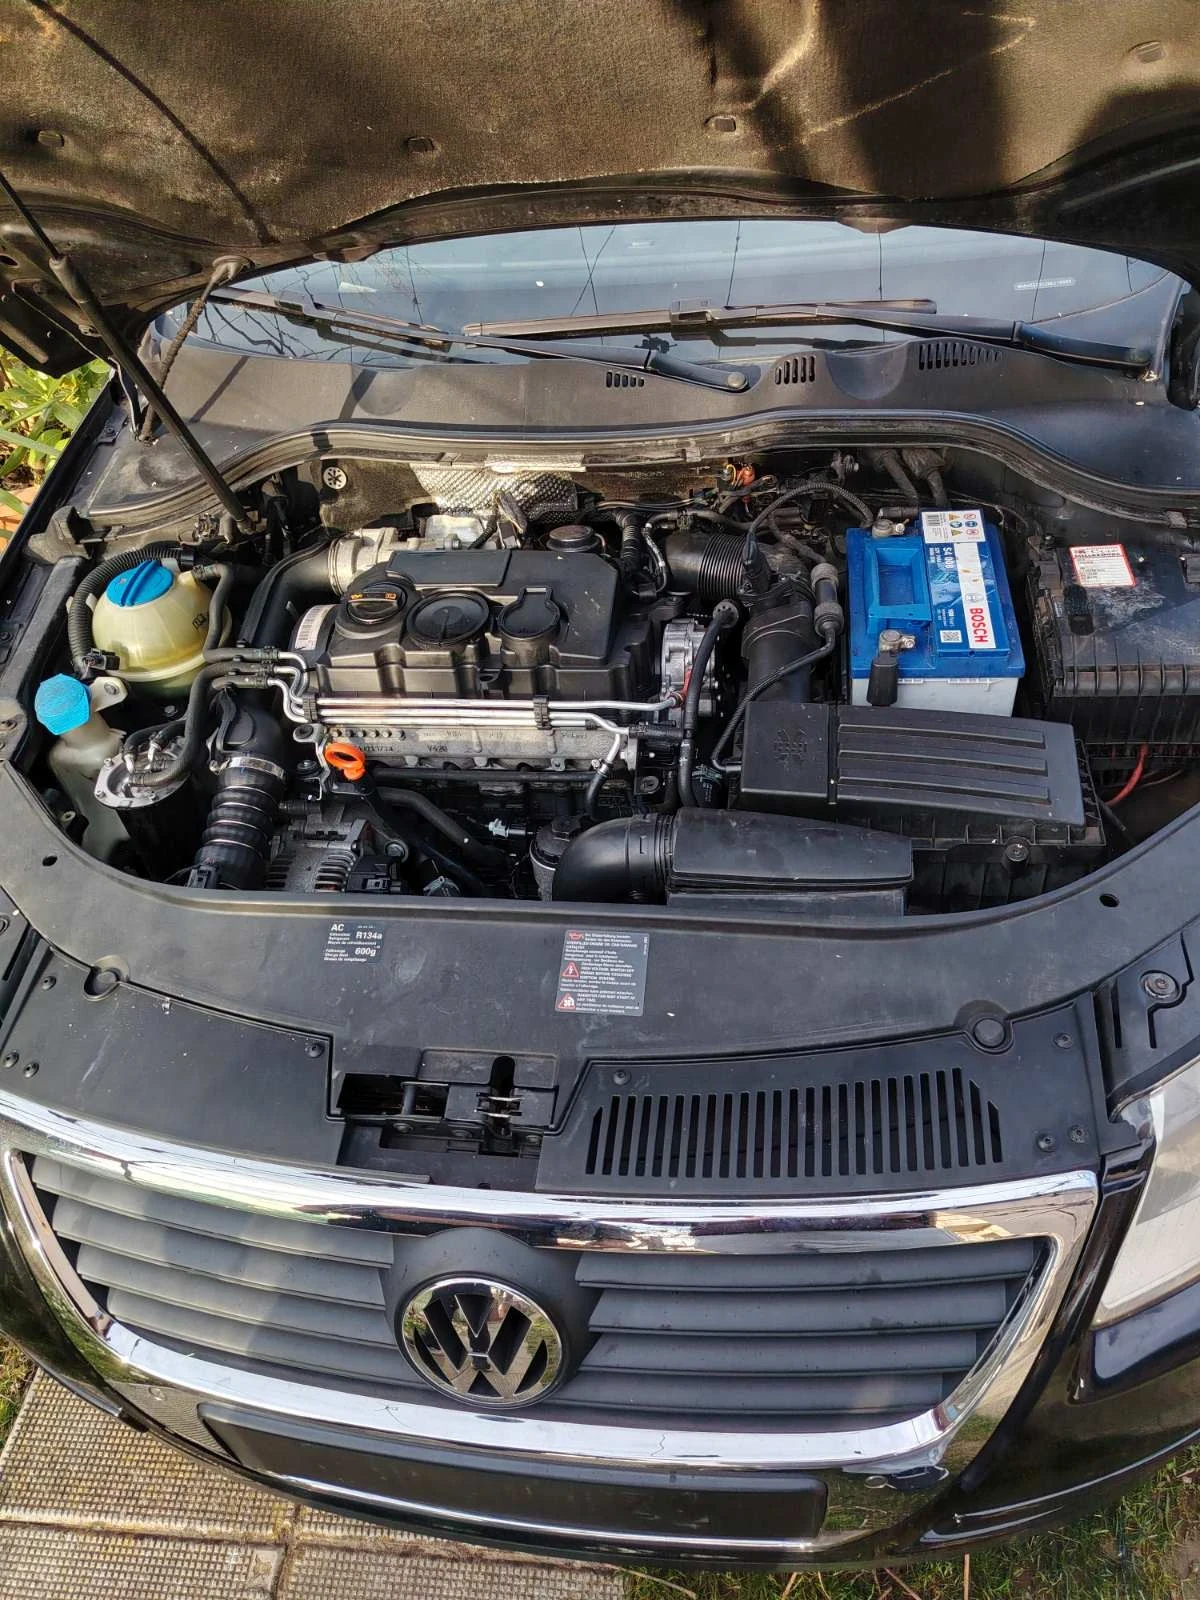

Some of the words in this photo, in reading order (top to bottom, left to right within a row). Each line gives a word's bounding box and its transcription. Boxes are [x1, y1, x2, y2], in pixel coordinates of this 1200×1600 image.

[969, 607, 988, 643] BOSCH
[331, 923, 345, 931] AC
[356, 931, 383, 940] R134a
[354, 947, 376, 957] 600g
[403, 1279, 562, 1404] VW
